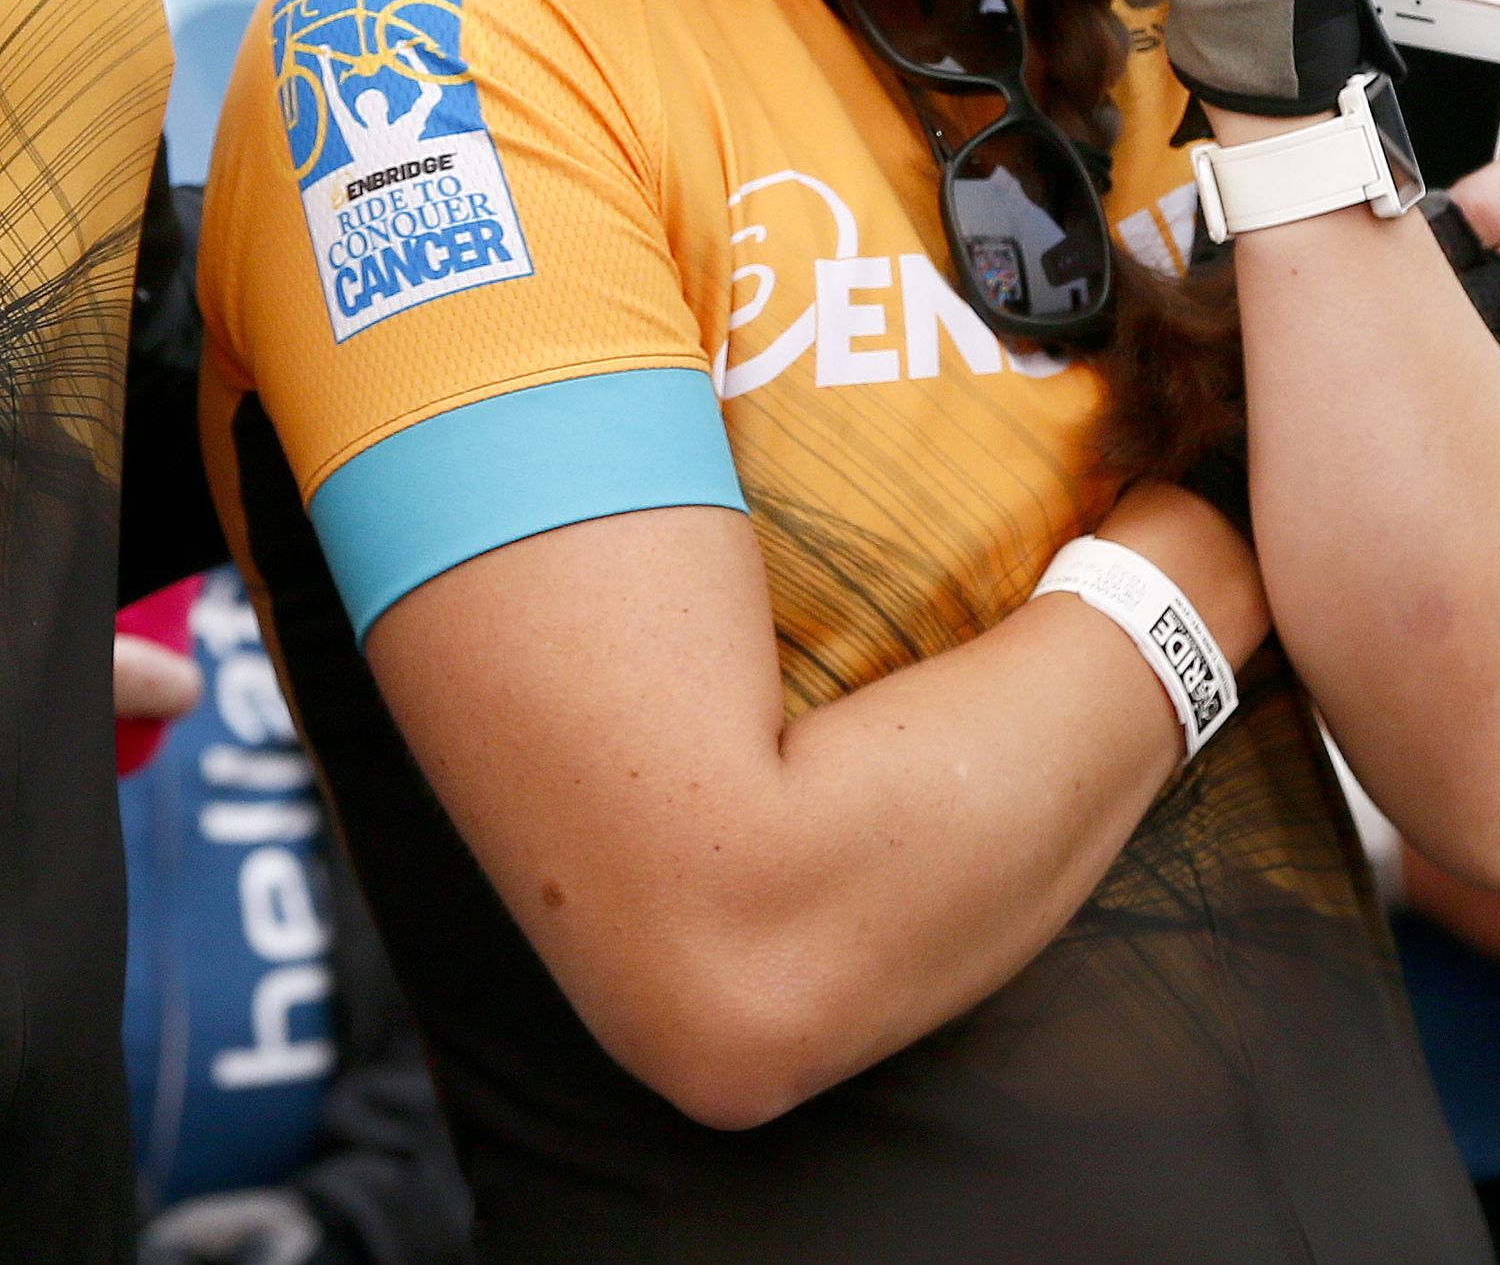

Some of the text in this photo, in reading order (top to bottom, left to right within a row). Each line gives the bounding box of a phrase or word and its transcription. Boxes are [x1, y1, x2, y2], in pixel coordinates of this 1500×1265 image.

[337, 175, 462, 235] RIDE TO
[346, 154, 455, 201] ENBRIDGE
[328, 193, 497, 269] CONQUER
[335, 219, 513, 317] CANCER
[1152, 609, 1210, 694] RIDE
